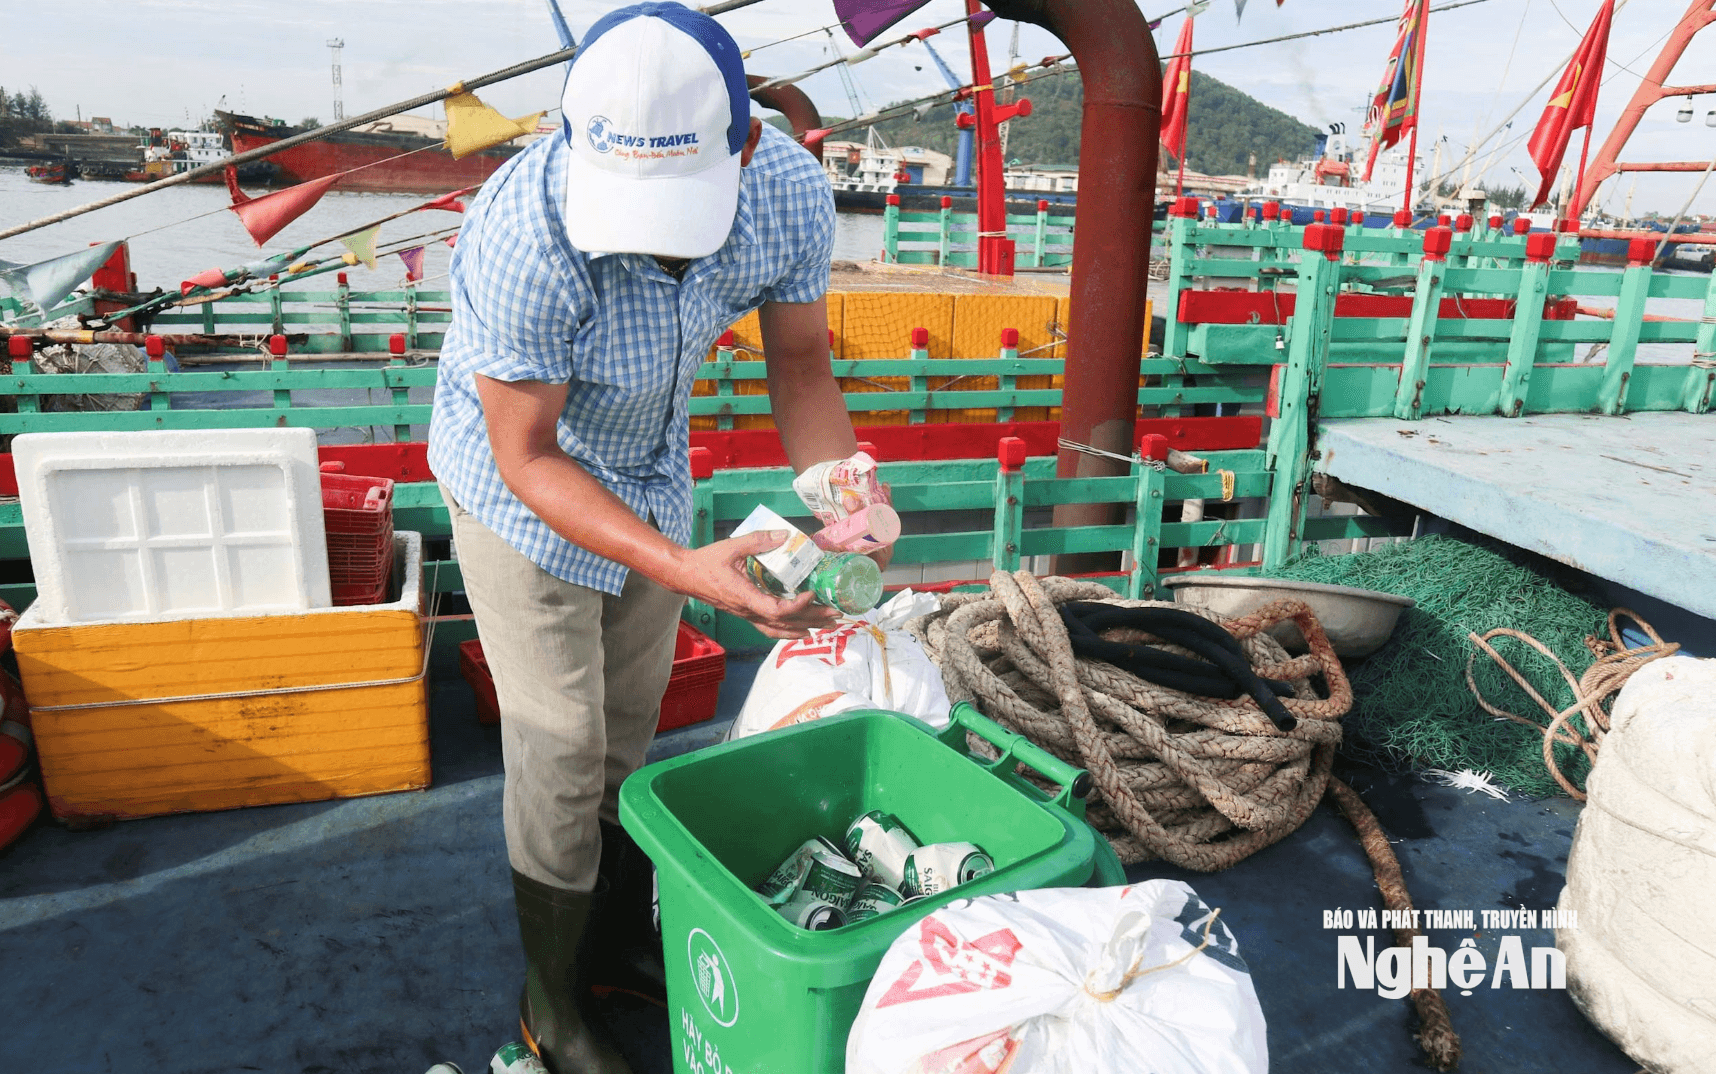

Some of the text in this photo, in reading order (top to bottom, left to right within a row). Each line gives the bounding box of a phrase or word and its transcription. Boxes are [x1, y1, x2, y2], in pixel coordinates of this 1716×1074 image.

[607, 132, 699, 148] NEWS TRAVEL
[812, 890, 850, 908] SAIGON
[705, 1039, 722, 1074] BỎ
